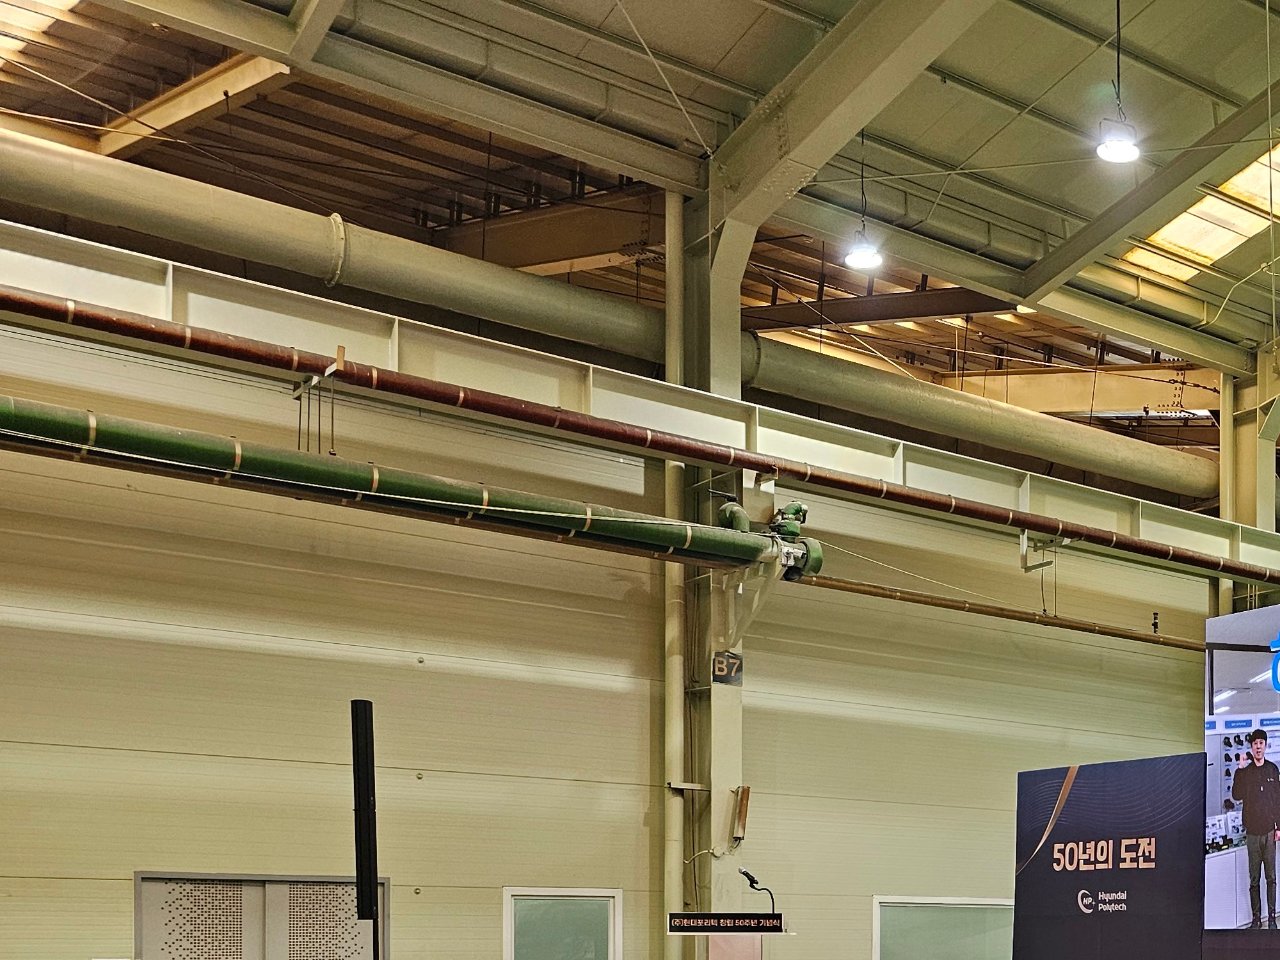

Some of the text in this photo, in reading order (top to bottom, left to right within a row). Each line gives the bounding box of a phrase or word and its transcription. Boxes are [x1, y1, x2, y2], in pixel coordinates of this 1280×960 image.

[714, 656, 741, 677] B7
[1053, 837, 1156, 872] 50년의 도전
[1098, 890, 1127, 902] Hyundai
[1098, 902, 1127, 913] Polytech
